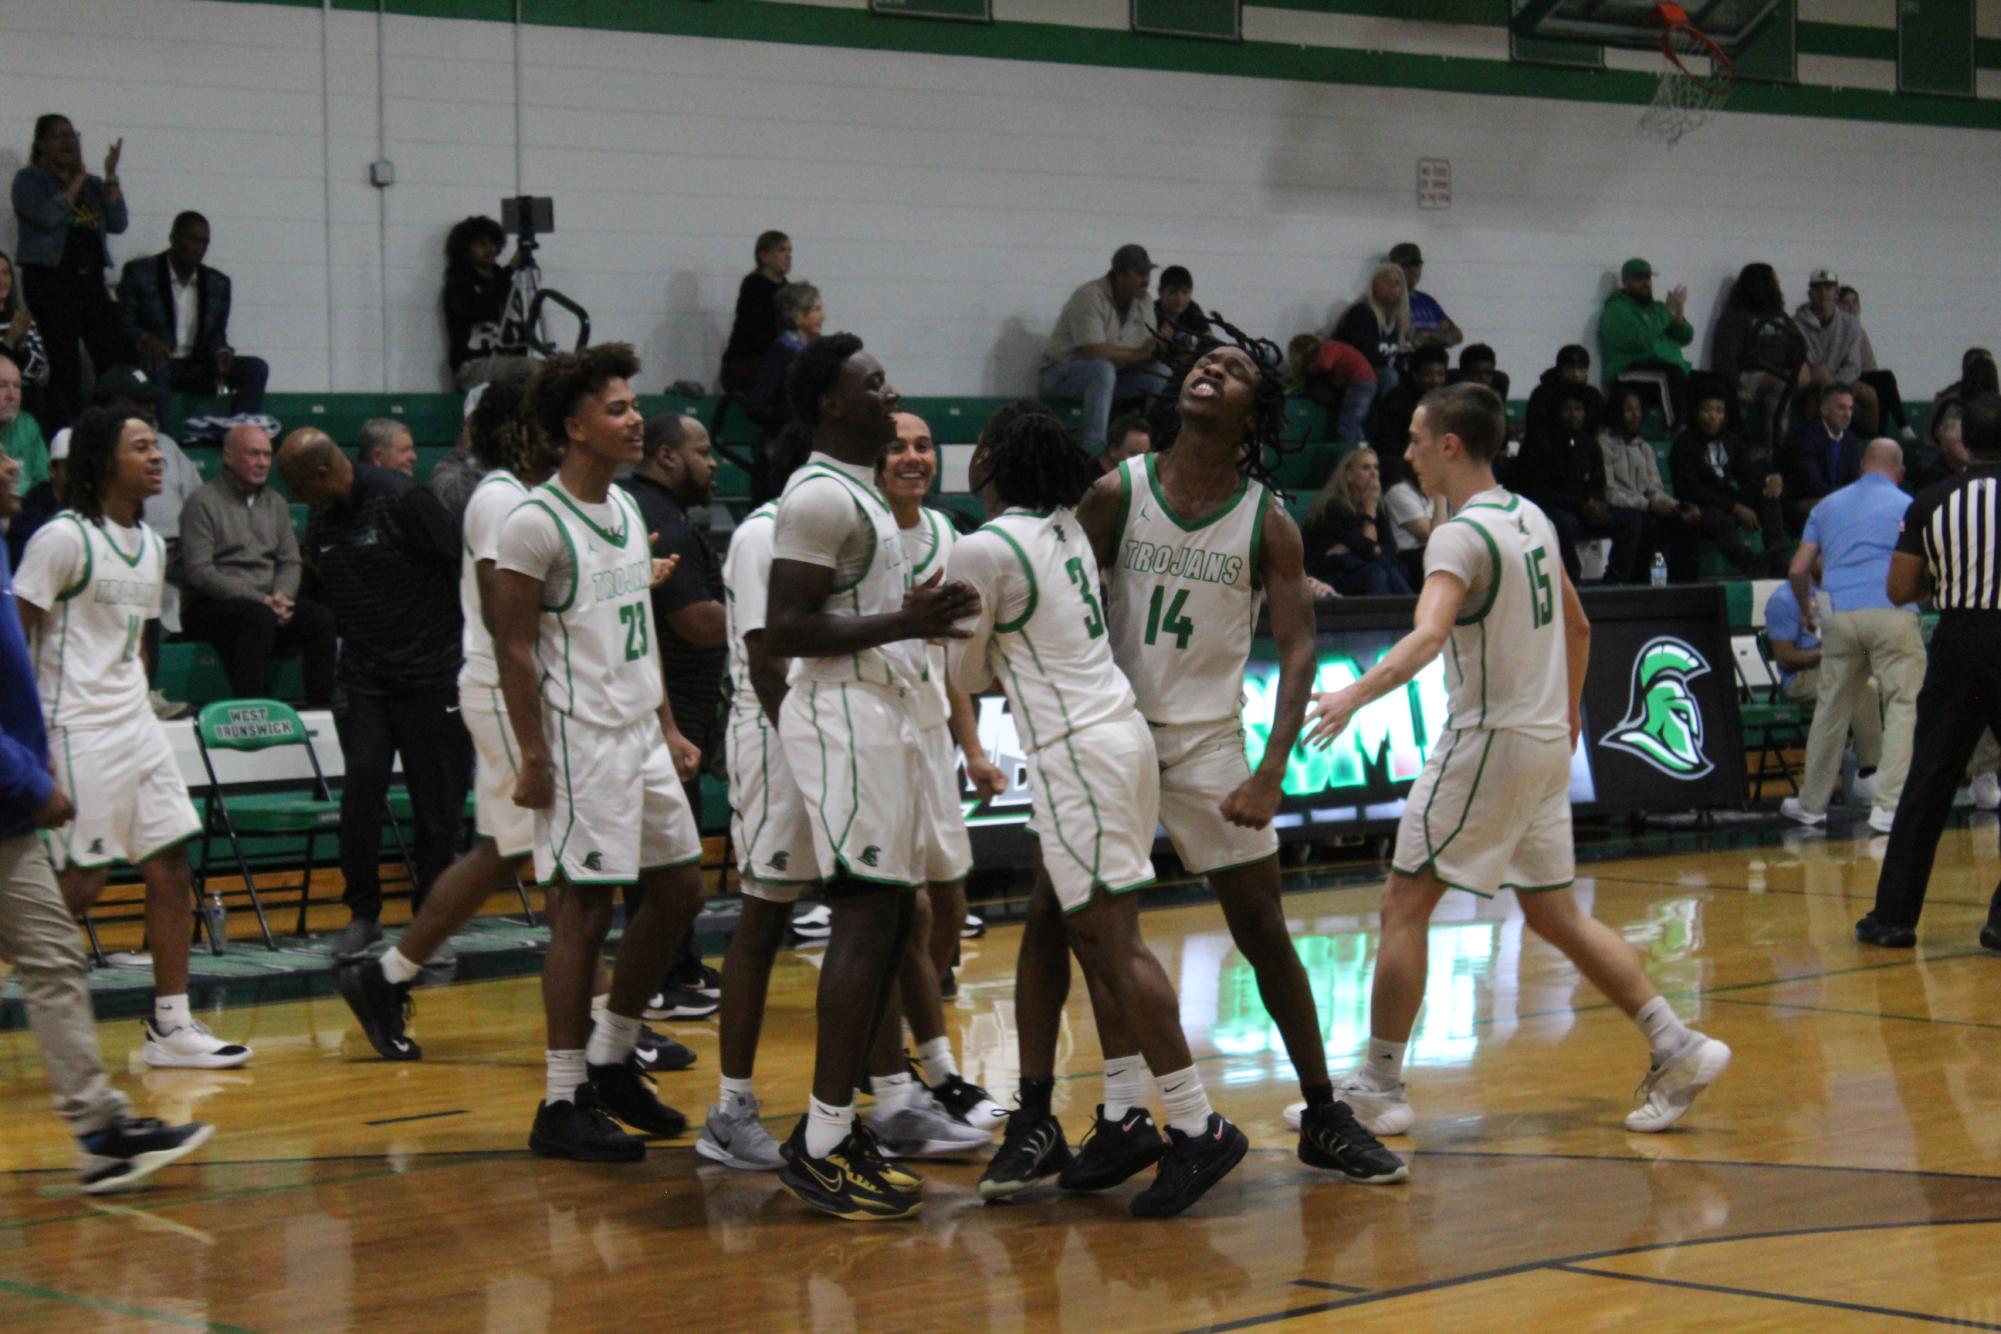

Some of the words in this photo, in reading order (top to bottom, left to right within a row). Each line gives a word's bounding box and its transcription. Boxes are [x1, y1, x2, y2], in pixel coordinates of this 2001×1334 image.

[1124, 539, 1243, 586] TROJANS
[1524, 545, 1553, 630] 15
[1065, 556, 1105, 640] 3
[1144, 584, 1194, 650] 14
[619, 600, 648, 662] 23
[215, 720, 293, 740] BRUNSWICK
[229, 707, 267, 722] WEST
